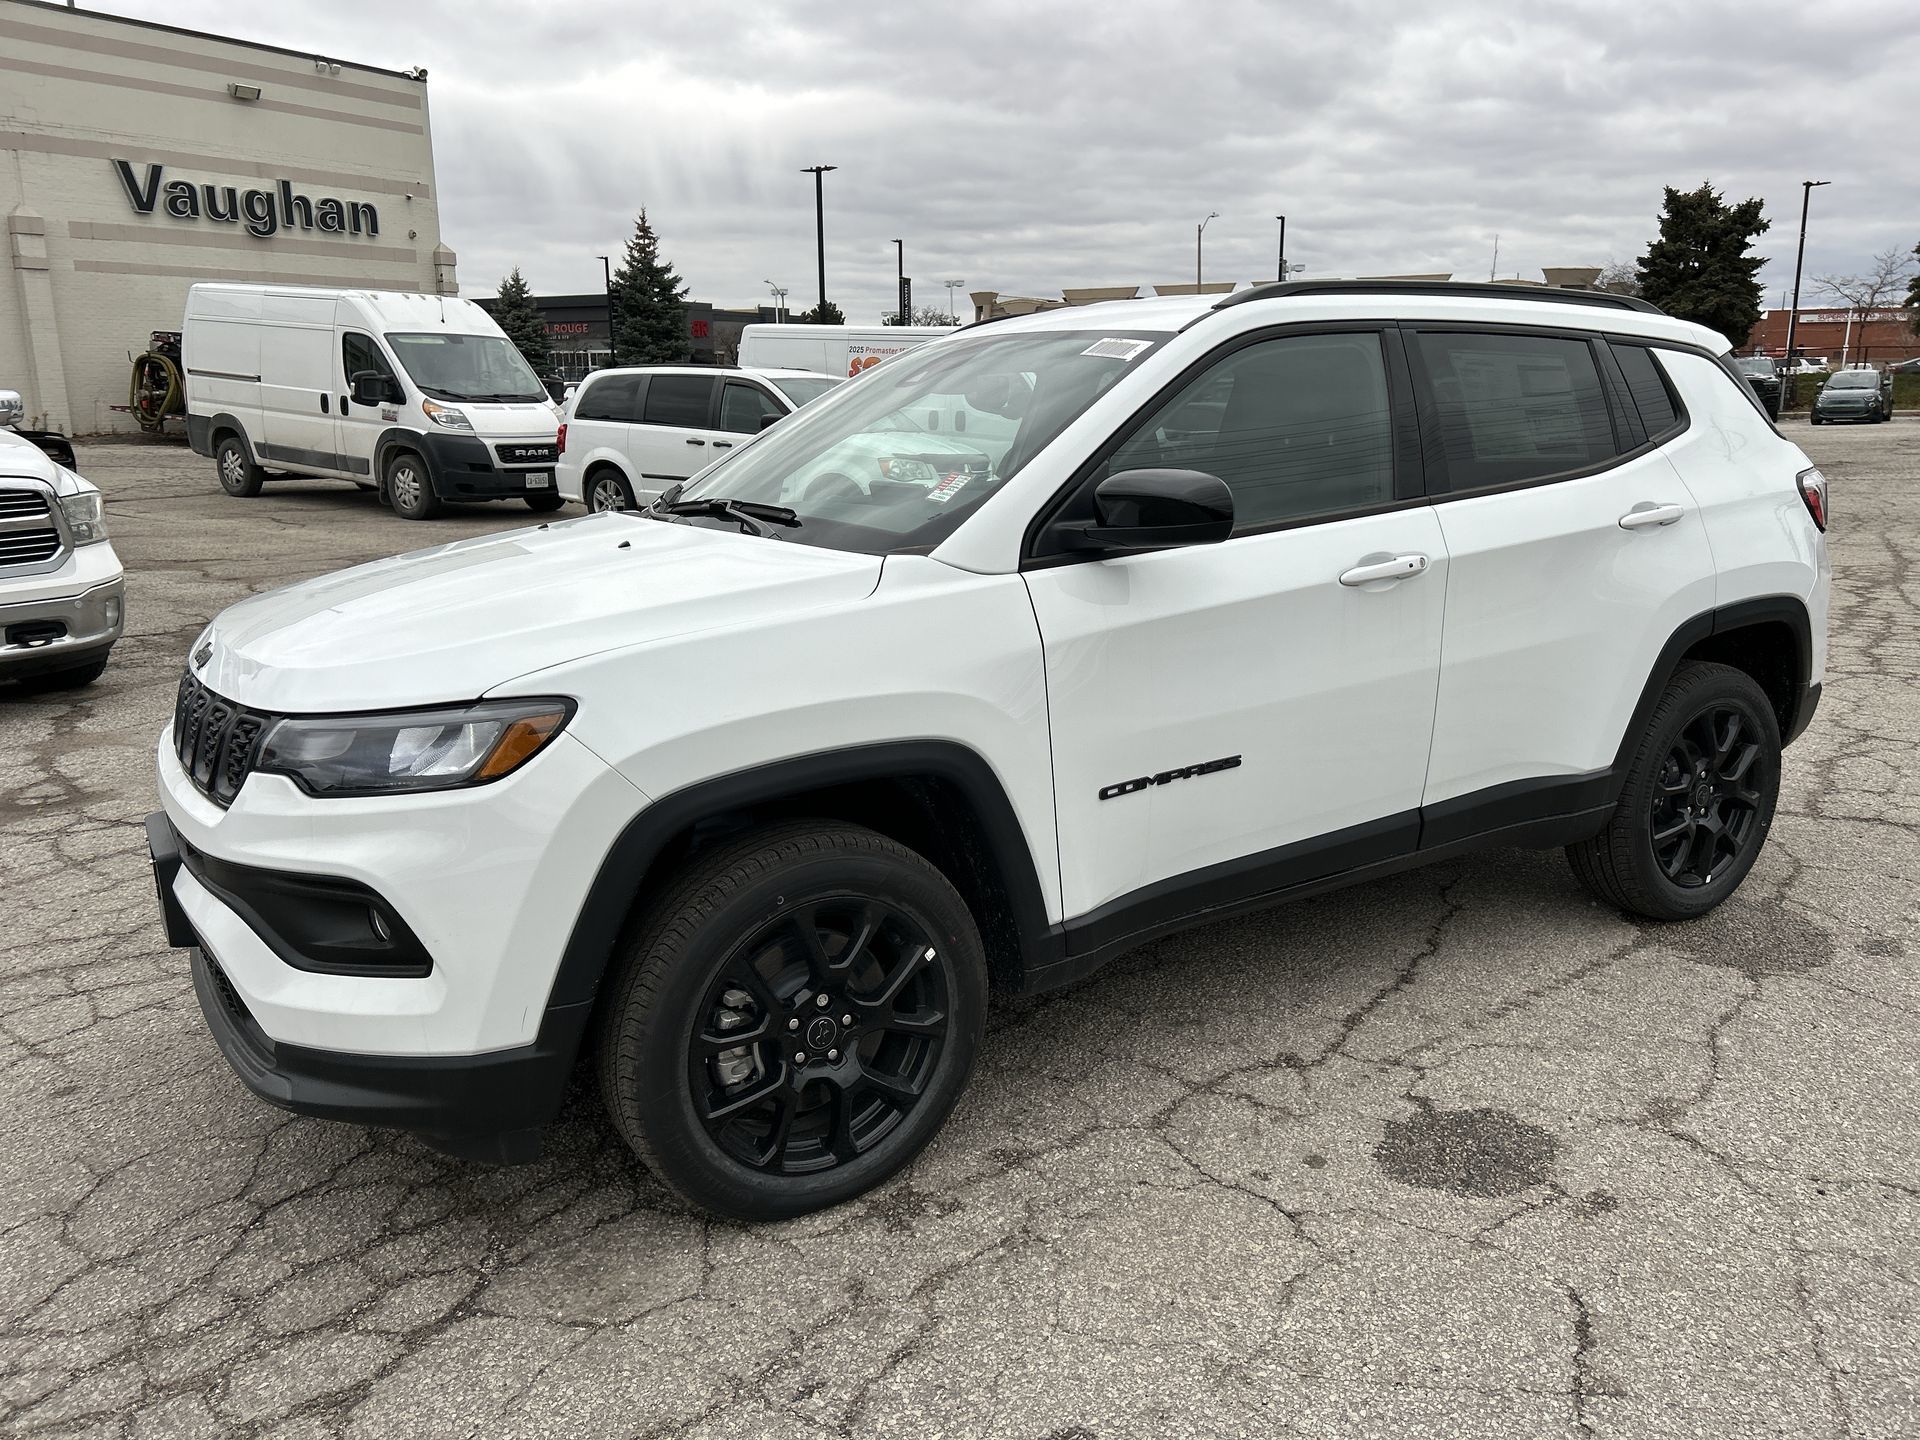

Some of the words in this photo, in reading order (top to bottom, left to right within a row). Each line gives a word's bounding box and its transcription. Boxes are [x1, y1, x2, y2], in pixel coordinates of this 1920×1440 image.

[112, 159, 381, 238] Vaughan
[553, 323, 589, 333] ROUGE
[849, 345, 864, 354] 2025
[865, 346, 898, 355] Promaster
[1099, 754, 1242, 800] COMPASS
